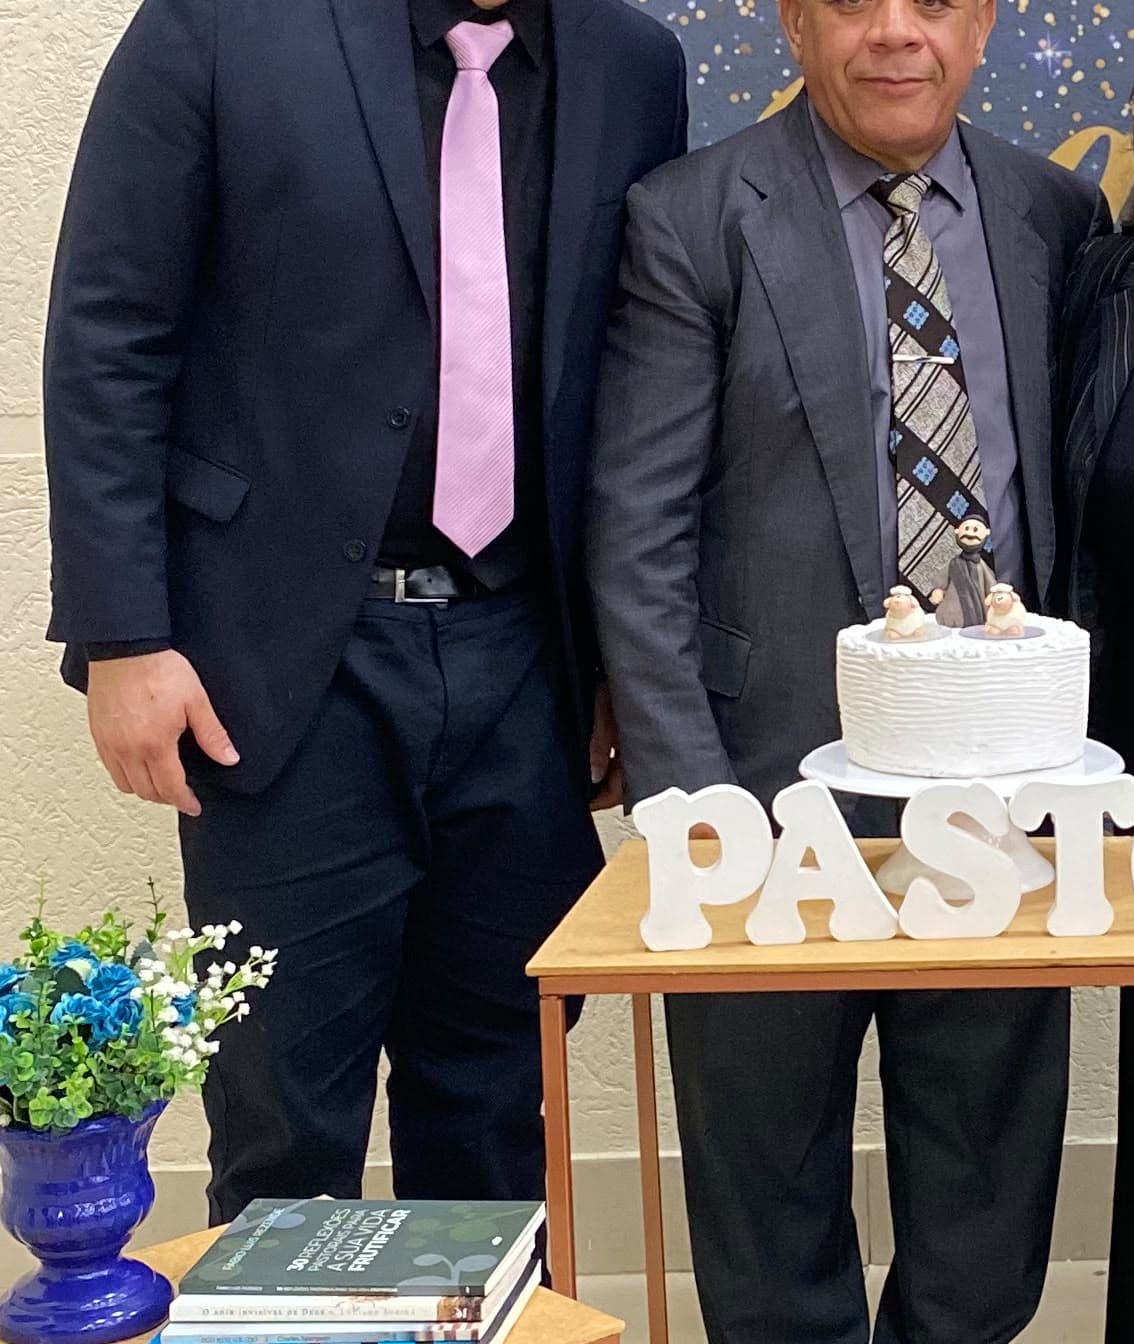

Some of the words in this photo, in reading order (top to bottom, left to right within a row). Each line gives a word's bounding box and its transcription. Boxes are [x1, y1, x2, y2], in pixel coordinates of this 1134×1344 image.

[286, 1258, 309, 1271] 30
[298, 1208, 351, 1258] REFLEXÕES
[307, 1230, 352, 1271] PASTORAIS
[342, 1208, 370, 1230] PARA
[347, 1209, 411, 1272] FRUTIFICAR
[353, 1208, 392, 1236] VIDA
[327, 1262, 348, 1271] A
[334, 1237, 368, 1261] SUA
